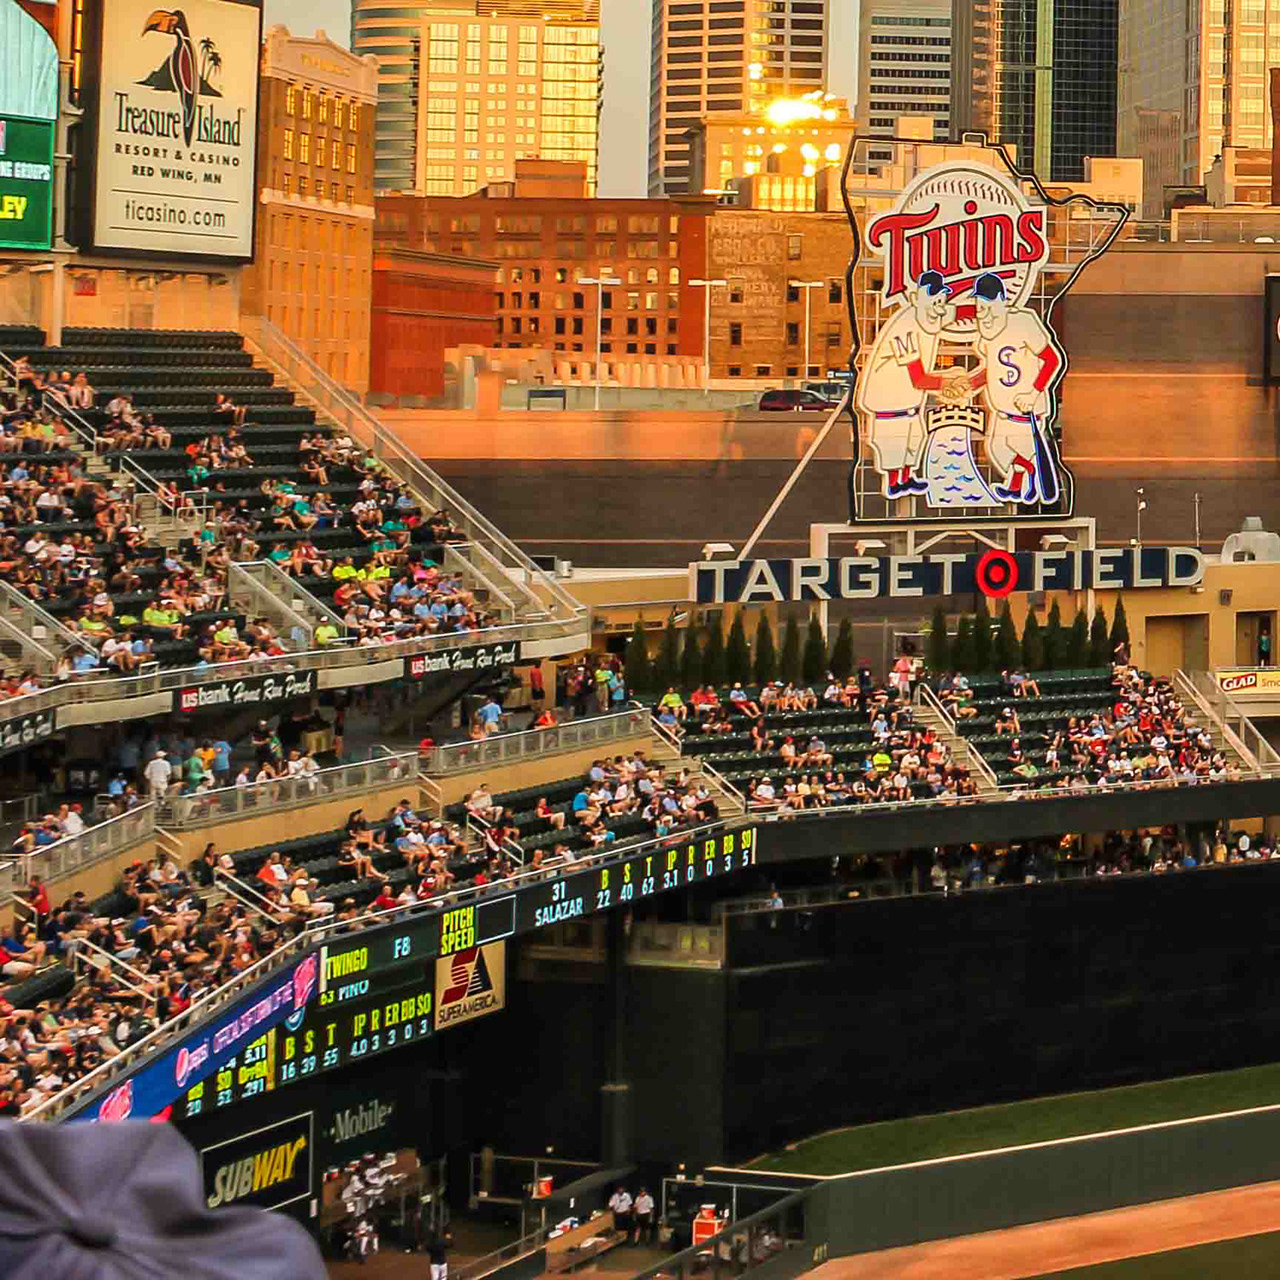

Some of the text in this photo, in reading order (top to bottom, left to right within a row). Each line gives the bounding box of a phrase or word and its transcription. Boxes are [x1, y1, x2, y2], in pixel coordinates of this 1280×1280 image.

[115, 91, 243, 147] Treasure Island
[115, 143, 240, 167] RESORT & CASINO
[132, 165, 222, 184] RED WING, MN
[125, 200, 226, 228] ticasino.com
[869, 200, 1044, 298] Twins
[709, 545, 1206, 602] TARGET FIELD
[263, 679, 282, 700] Run
[1222, 675, 1256, 691] GLAD
[552, 881, 567, 901] 31
[442, 905, 474, 936] PITCH
[535, 896, 583, 927] SALAZAR
[441, 926, 475, 955] SPEED
[338, 979, 369, 1001] PINO
[439, 994, 497, 1024] SUPERAMERICA
[333, 1099, 387, 1143] Mobile
[208, 1135, 307, 1208] SUBWAY
